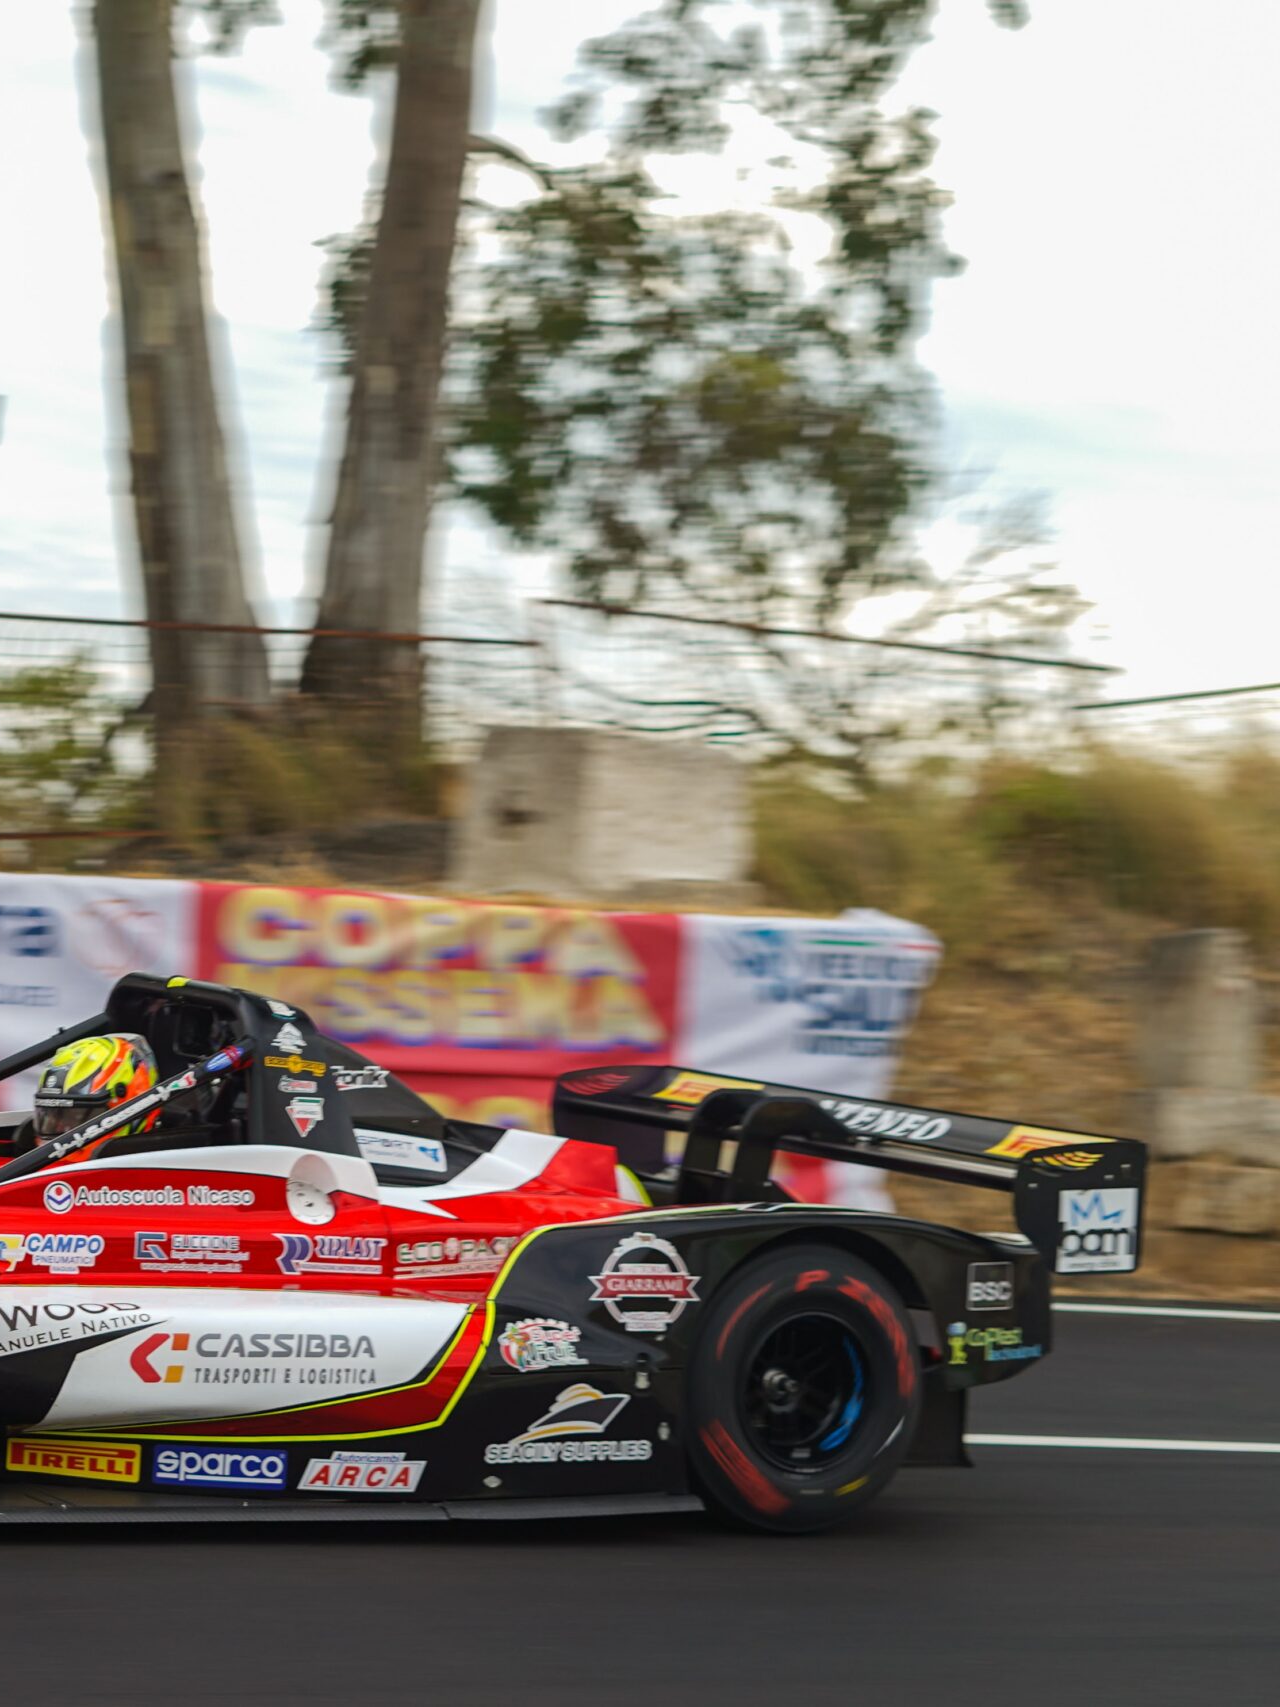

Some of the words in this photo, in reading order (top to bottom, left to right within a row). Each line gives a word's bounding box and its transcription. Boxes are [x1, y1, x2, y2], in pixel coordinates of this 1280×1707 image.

[222, 887, 646, 986] COPPA
[819, 1100, 952, 1140] TENEO
[76, 1186, 184, 1206] Autoscuola
[190, 1187, 254, 1206] Nicaso
[27, 1235, 102, 1255] CAMPO
[317, 1237, 384, 1258] RIPLAST
[970, 1282, 1012, 1302] BSC
[81, 1313, 151, 1335] NATIVO
[196, 1333, 376, 1358] CASSIBBA
[194, 1368, 276, 1384] TRASPORTI
[283, 1368, 291, 1384] E
[299, 1368, 377, 1385] LOGISTICA
[9, 1443, 137, 1476] PIRELLI
[485, 1443, 558, 1464] SEACILY
[560, 1440, 652, 1462] SUPPLIES
[157, 1449, 284, 1481] sparco
[310, 1465, 410, 1488] ARCA
